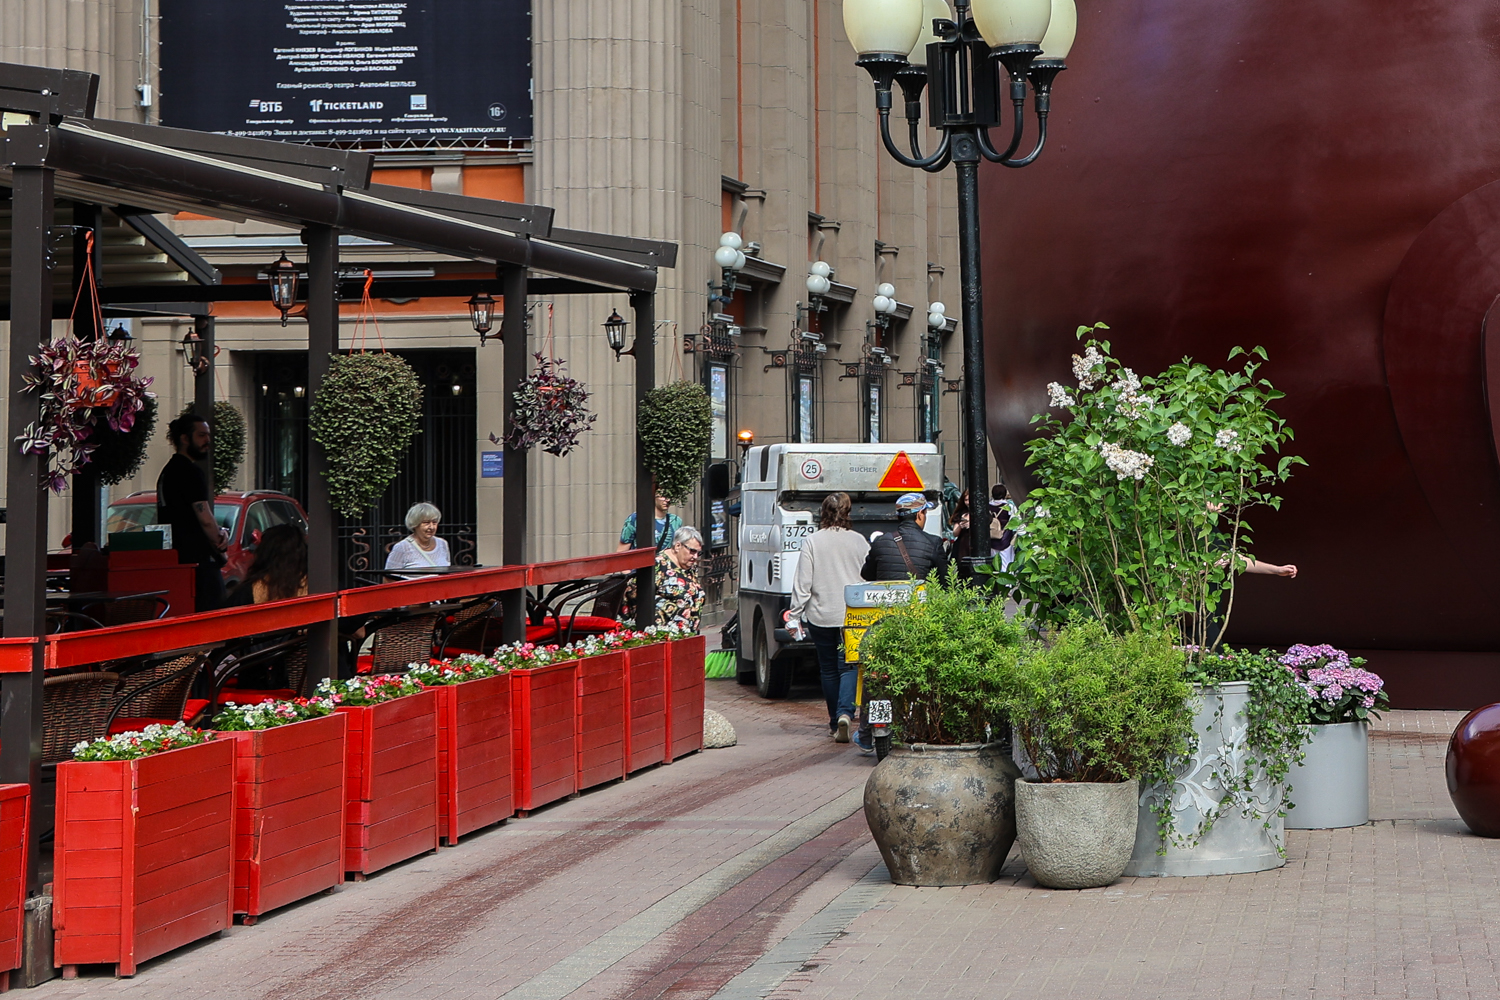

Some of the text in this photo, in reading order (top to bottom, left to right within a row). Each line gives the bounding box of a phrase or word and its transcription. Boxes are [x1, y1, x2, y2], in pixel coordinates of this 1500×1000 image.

[259, 101, 283, 112] ВТБ
[323, 101, 384, 110] TICKETLAND
[489, 106, 505, 117] 16+
[805, 464, 817, 474] 25
[785, 526, 815, 538] 3729
